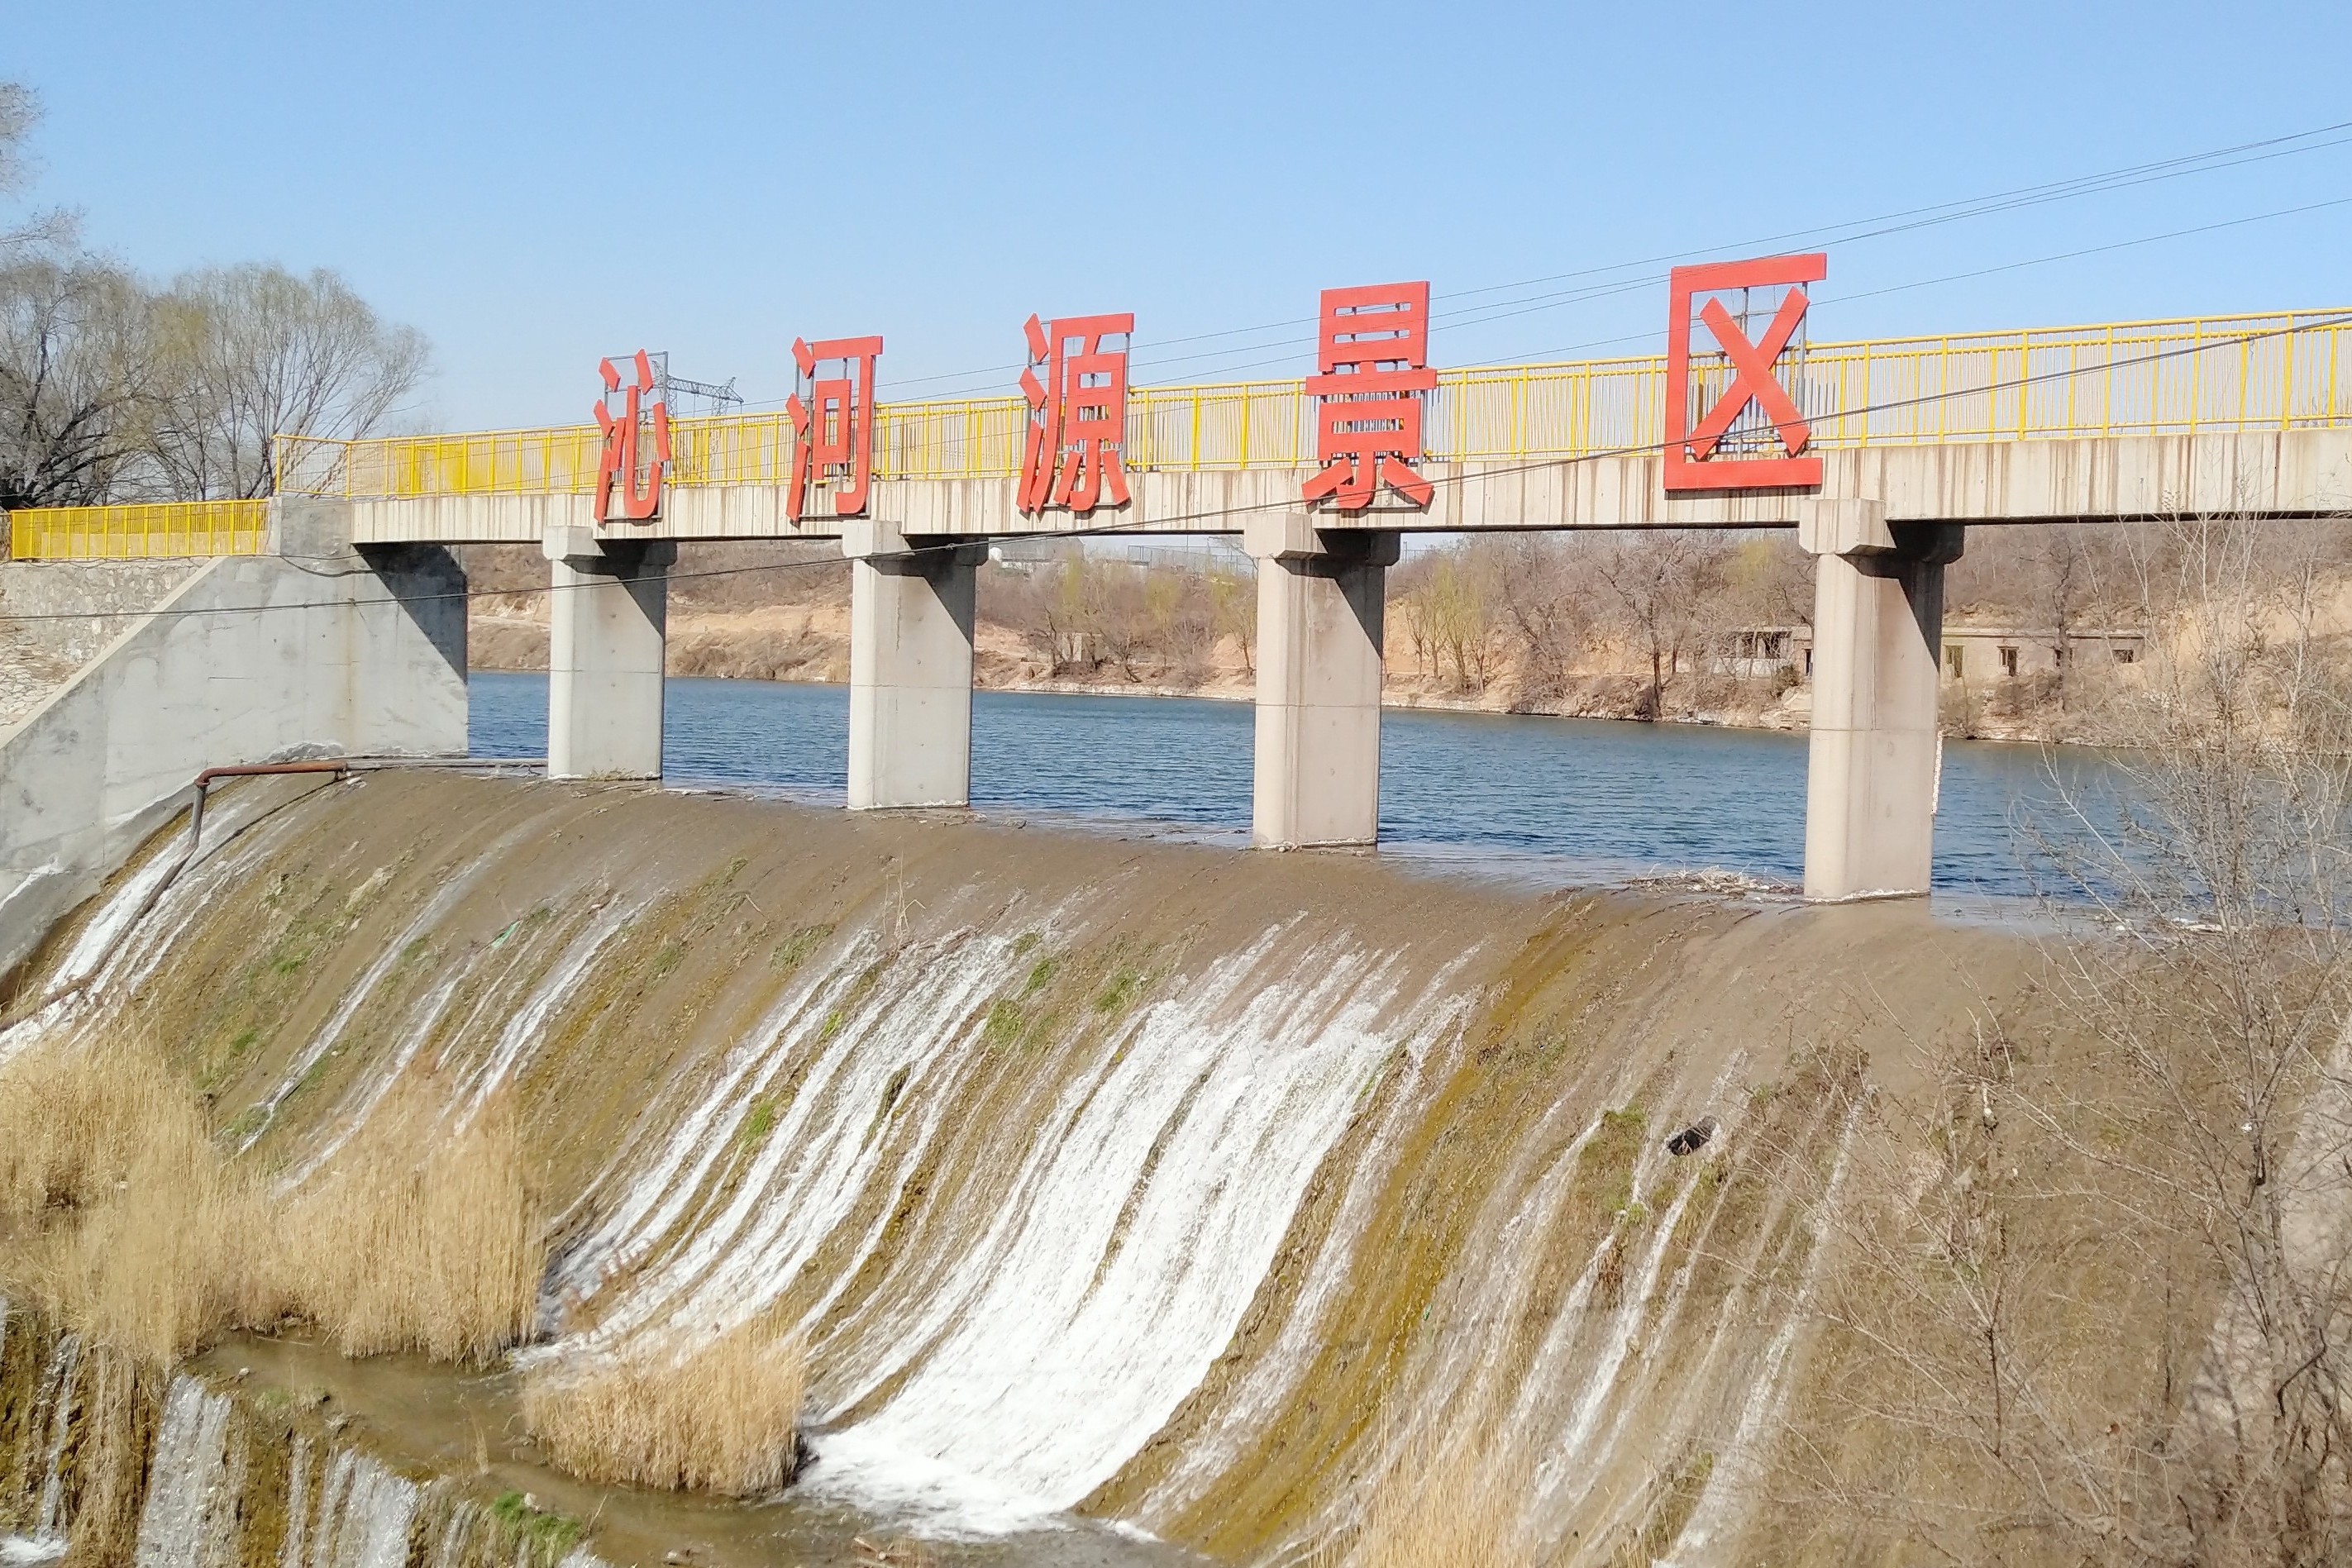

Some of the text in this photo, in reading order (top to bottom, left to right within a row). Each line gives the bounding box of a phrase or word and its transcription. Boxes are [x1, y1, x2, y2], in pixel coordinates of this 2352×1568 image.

[593, 252, 1828, 522] 沁河源景区
